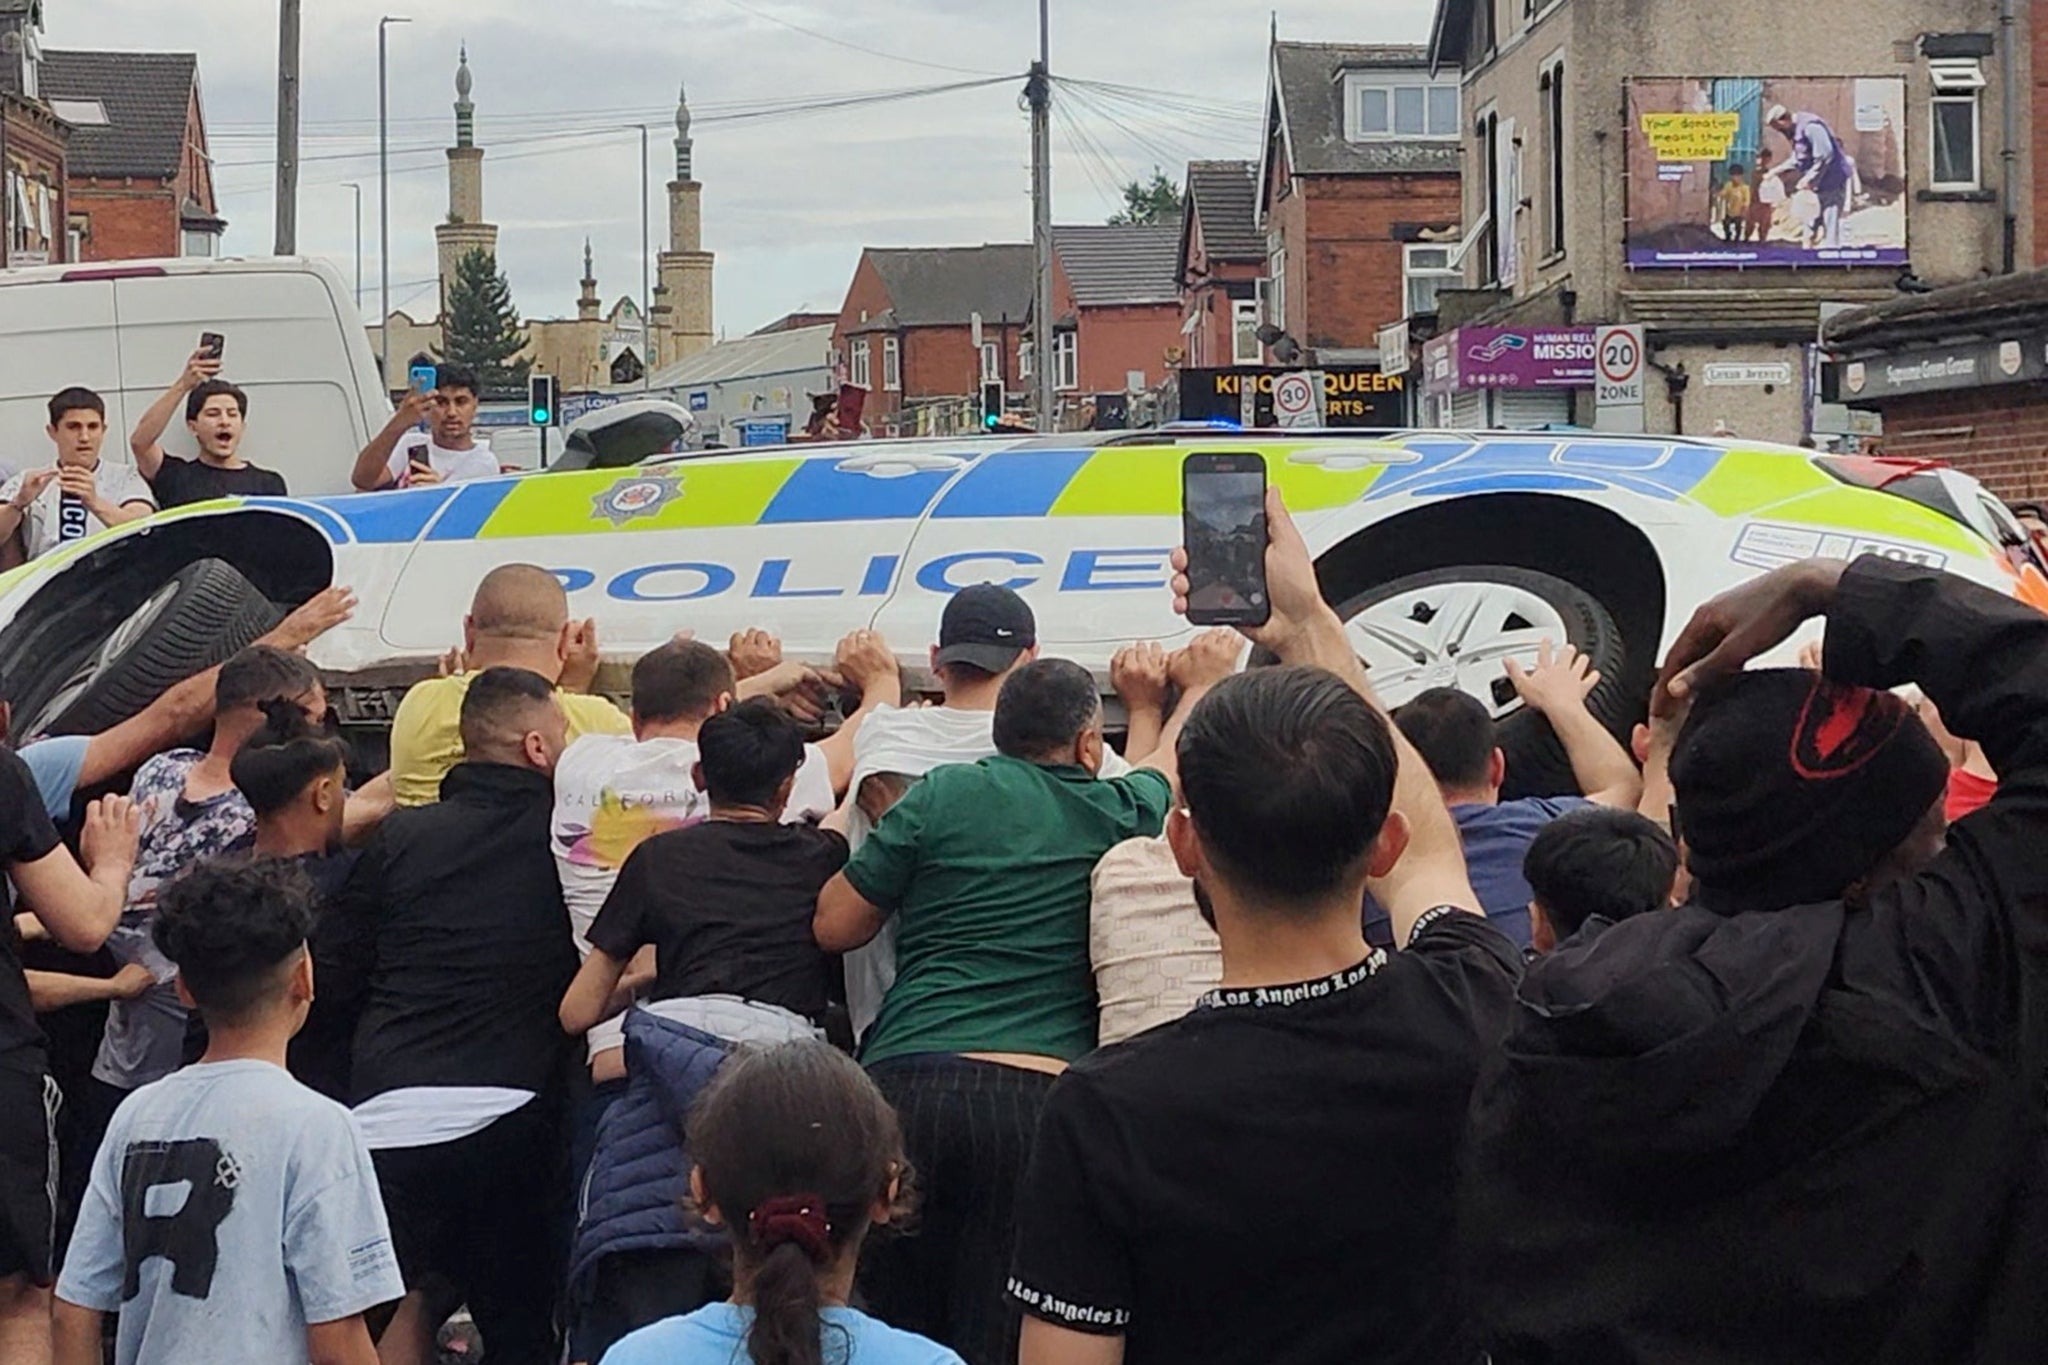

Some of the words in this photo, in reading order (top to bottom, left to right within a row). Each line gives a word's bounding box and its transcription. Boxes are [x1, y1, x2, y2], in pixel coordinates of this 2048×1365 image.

[1644, 118, 1672, 129] Your
[1681, 118, 1736, 129] donation
[1653, 134, 1694, 142] means
[1700, 132, 1730, 142] they
[1687, 147, 1723, 157] today
[1534, 334, 1570, 343] HUMAN
[1607, 345, 1633, 365] 20
[1324, 374, 1403, 395] QUEEN
[1600, 385, 1639, 398] ZONE
[1282, 387, 1306, 403] 30
[548, 550, 1176, 600] POLICE
[1211, 990, 1250, 1009] Los
[1254, 982, 1329, 1007] Angeles
[1330, 966, 1368, 991] Los
[1013, 1281, 1040, 1304] Los
[1040, 1294, 1112, 1324] Angeles
